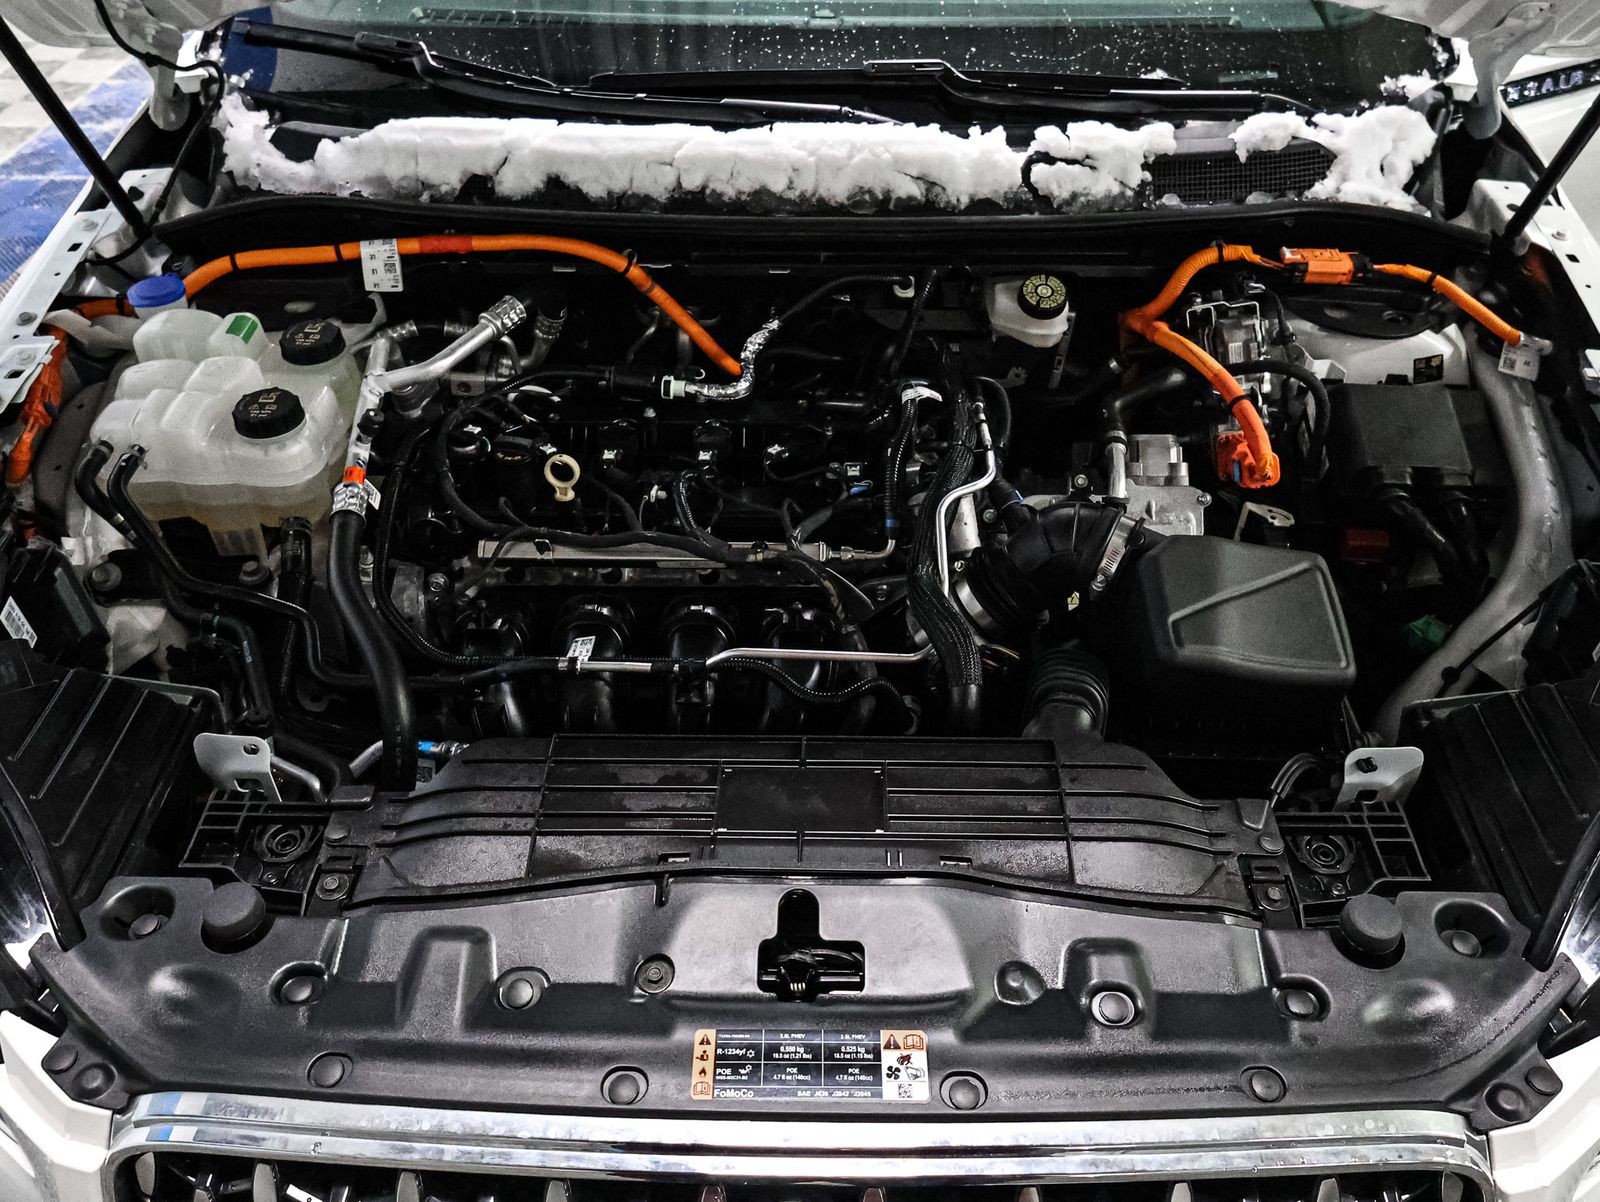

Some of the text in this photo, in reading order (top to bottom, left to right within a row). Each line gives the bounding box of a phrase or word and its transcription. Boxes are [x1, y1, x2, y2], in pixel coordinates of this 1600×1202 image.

[717, 1048, 746, 1056] R-1234yf
[796, 1045, 804, 1054] kg
[857, 1046, 865, 1054] kg
[713, 1088, 754, 1098] FoMoCo
